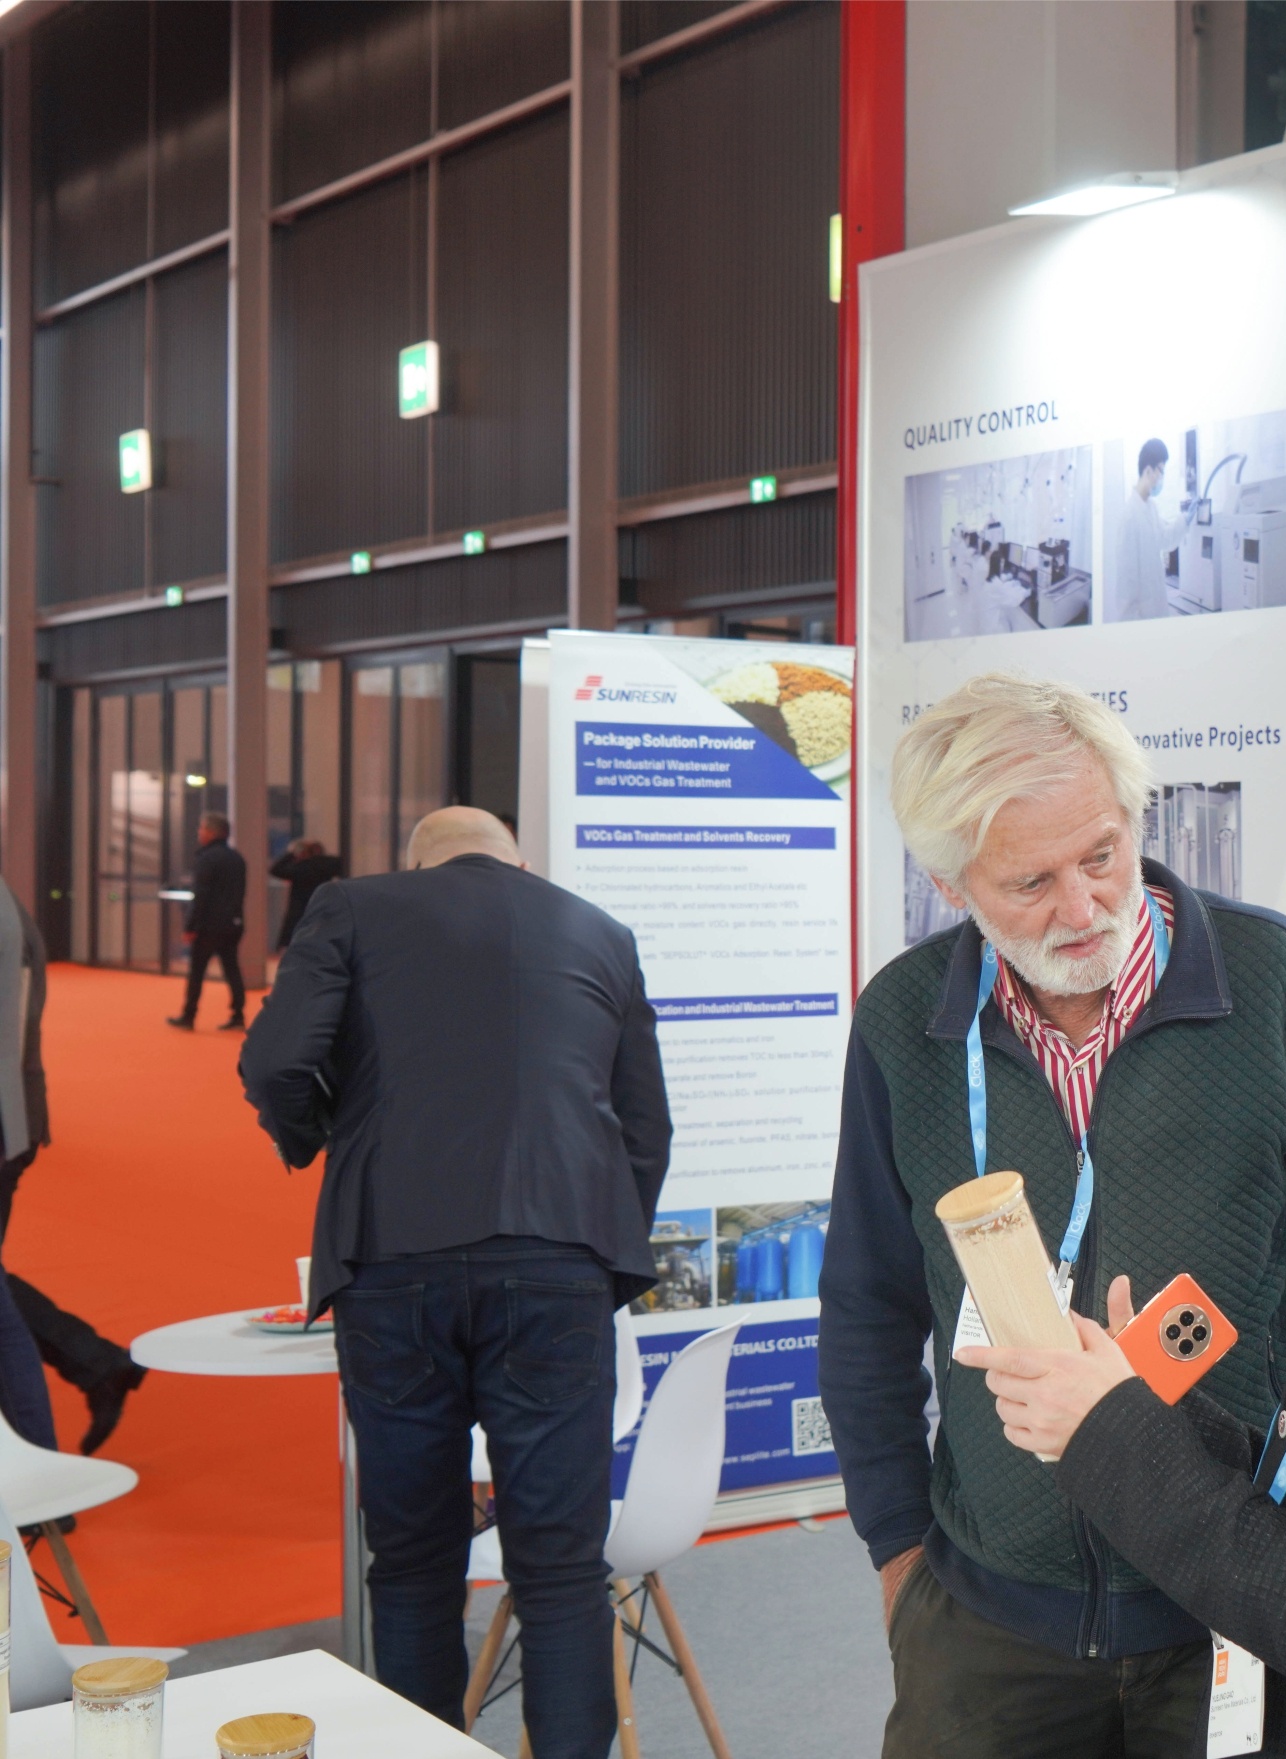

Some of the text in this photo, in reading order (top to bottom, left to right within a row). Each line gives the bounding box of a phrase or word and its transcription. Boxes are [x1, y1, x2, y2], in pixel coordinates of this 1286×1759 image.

[904, 399, 1059, 450] QUALITY CONTROL
[596, 688, 677, 704] SUNRESIN
[583, 731, 757, 751] Package Solution Provider
[1209, 724, 1281, 756] Projects
[596, 757, 612, 769] for
[614, 758, 665, 771] Industrial
[667, 760, 731, 772] Wastewater
[595, 774, 732, 789] and VOCs Gas Treatment
[583, 829, 791, 845] VOCs Gas Treatment and Solvents Recovery
[685, 1003, 701, 1015] and
[702, 1001, 742, 1015] Industrial
[743, 1000, 794, 1013] Wastewater
[795, 999, 836, 1012] Treatment
[640, 1351, 669, 1367] ESIN
